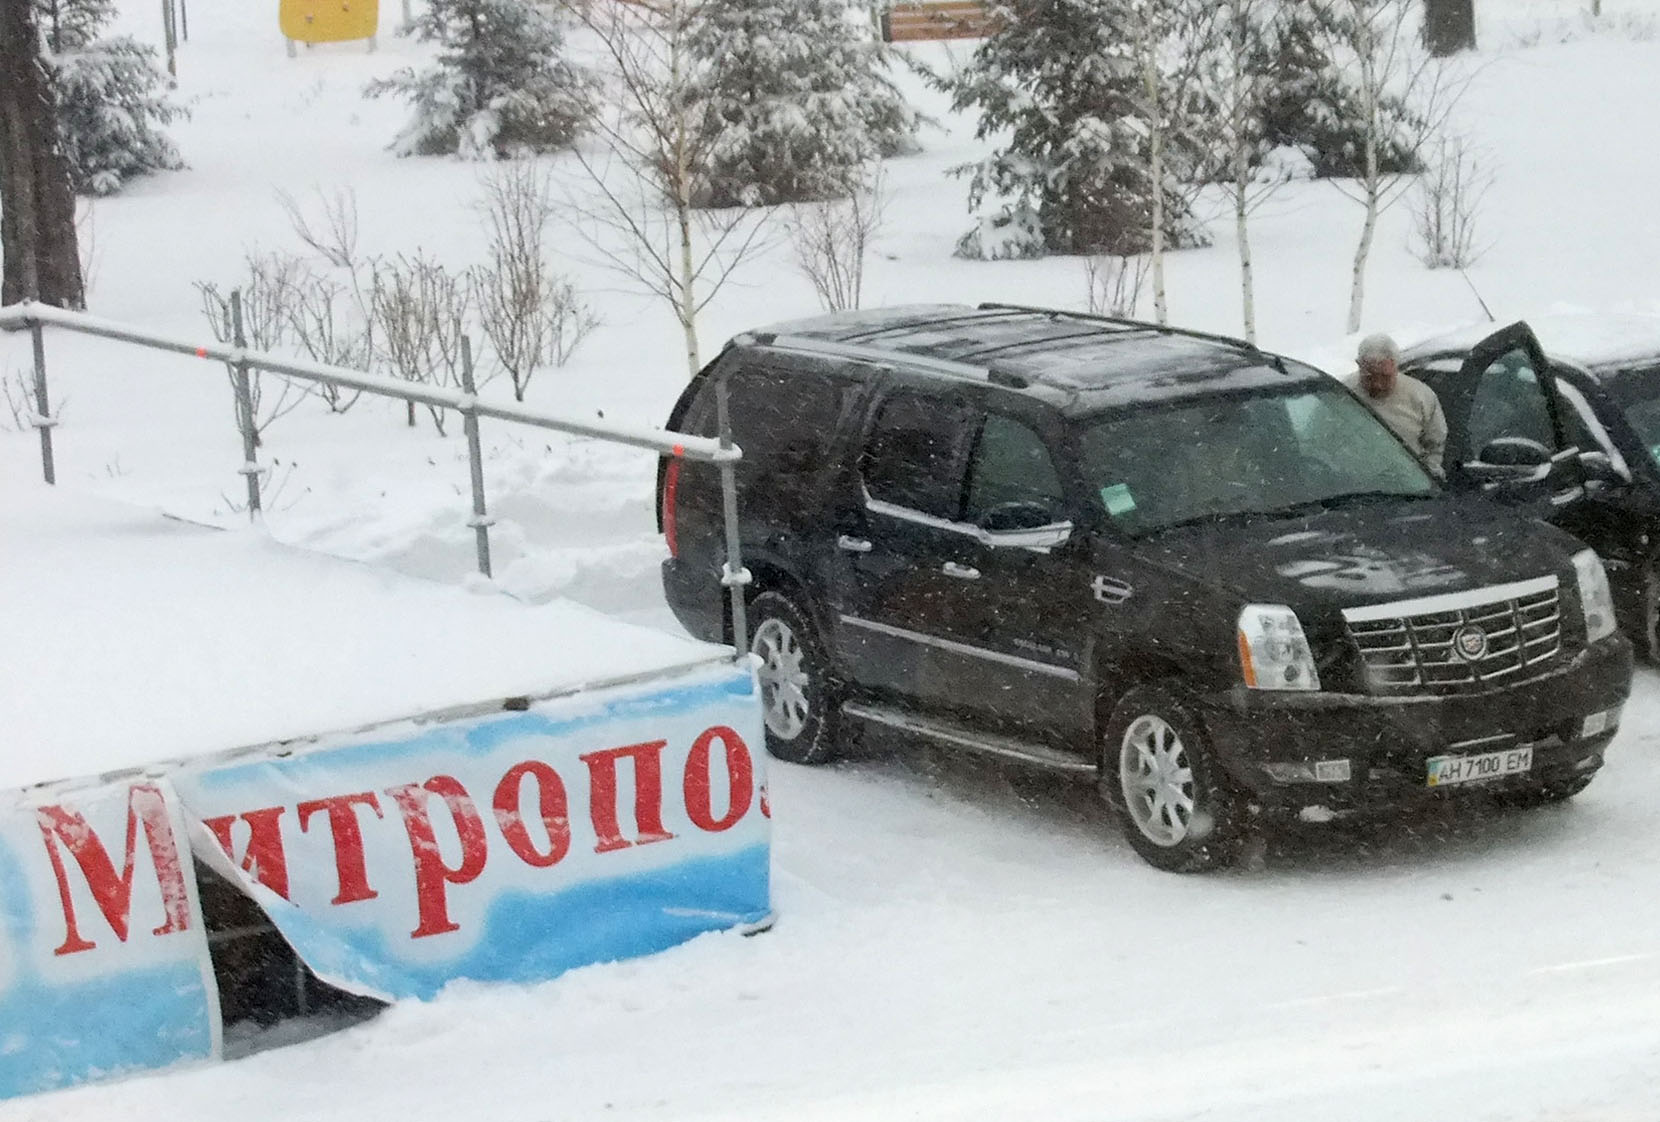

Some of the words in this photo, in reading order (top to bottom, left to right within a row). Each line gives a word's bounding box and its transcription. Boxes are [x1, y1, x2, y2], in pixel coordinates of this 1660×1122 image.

[1439, 762, 1462, 780] AH
[1466, 756, 1501, 777] 7100
[1507, 753, 1529, 770] EM
[38, 724, 771, 956] Митропо
